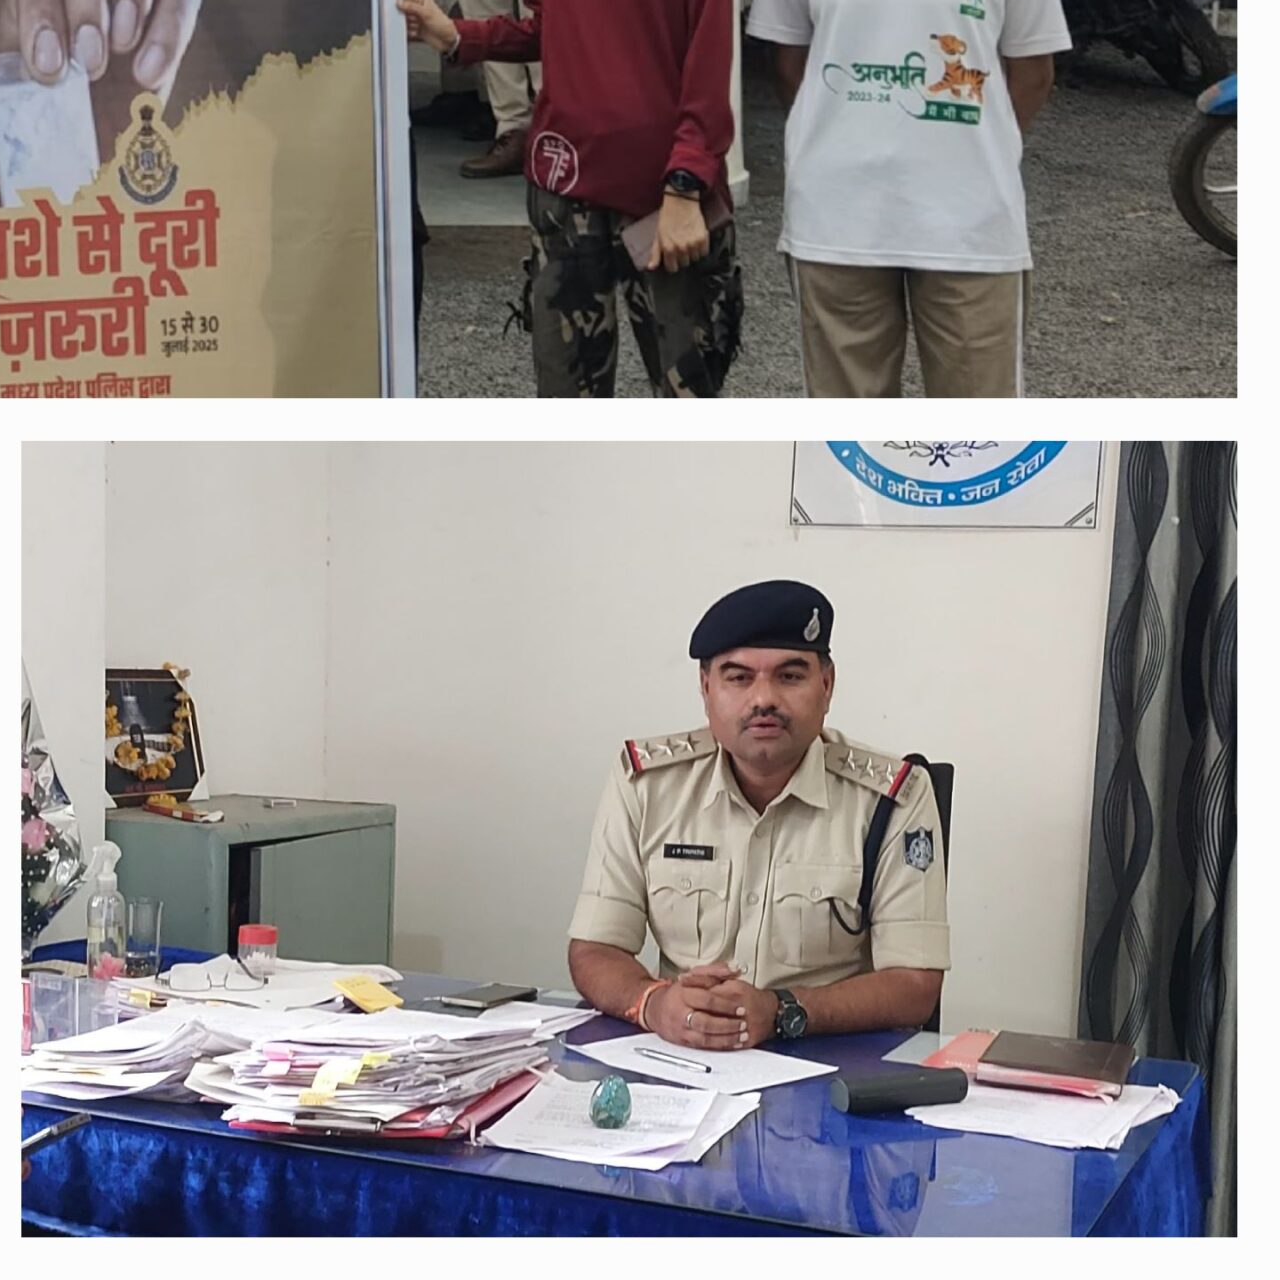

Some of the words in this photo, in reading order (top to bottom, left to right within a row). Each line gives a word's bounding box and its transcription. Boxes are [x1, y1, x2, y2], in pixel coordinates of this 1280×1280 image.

[72, 196, 125, 275] से
[133, 188, 220, 297] दूरी
[160, 318, 177, 337] 15
[180, 310, 195, 334] से
[199, 315, 219, 334] 30
[192, 338, 218, 353] 2025
[855, 452, 883, 489] देश
[887, 479, 943, 505] भक्ति
[960, 479, 1001, 503] जन
[1007, 446, 1047, 486] सेवा
